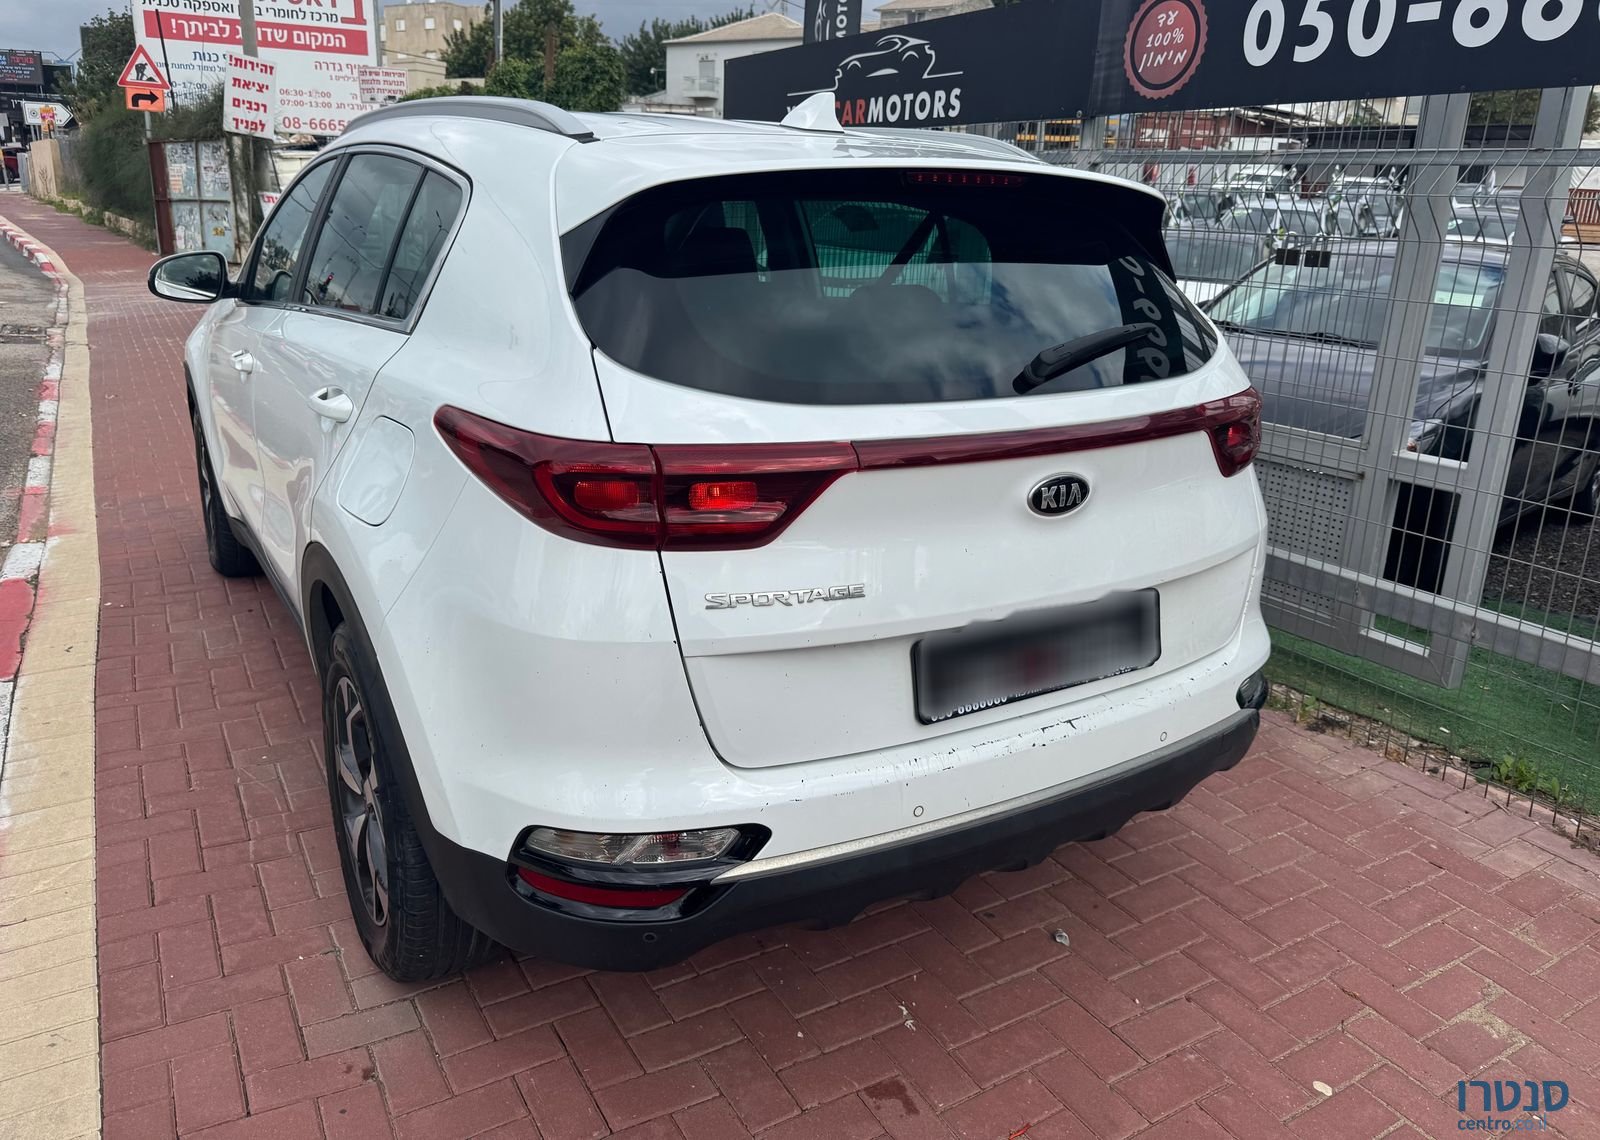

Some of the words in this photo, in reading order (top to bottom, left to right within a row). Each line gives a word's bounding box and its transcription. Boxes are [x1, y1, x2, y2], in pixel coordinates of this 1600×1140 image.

[183, 0, 234, 13] ואספקה
[265, 7, 306, 20] לחומרי
[309, 11, 338, 23] מרכז
[1157, 10, 1179, 27] עד
[171, 18, 230, 38] לביתך!
[236, 25, 287, 43] שדוג
[293, 31, 346, 49] המקום
[1146, 27, 1184, 47] 100%
[229, 55, 274, 75] זהירות!
[314, 60, 343, 72] גדרה
[1138, 49, 1187, 72] מימון
[232, 77, 269, 93] יציאת
[232, 97, 267, 113] רכבים
[280, 99, 332, 109] 07:00-13:00
[232, 117, 266, 132] לפניך
[282, 116, 349, 131] 08-6665
[1040, 483, 1082, 510] KIA
[704, 583, 866, 610] SPORTAGE
